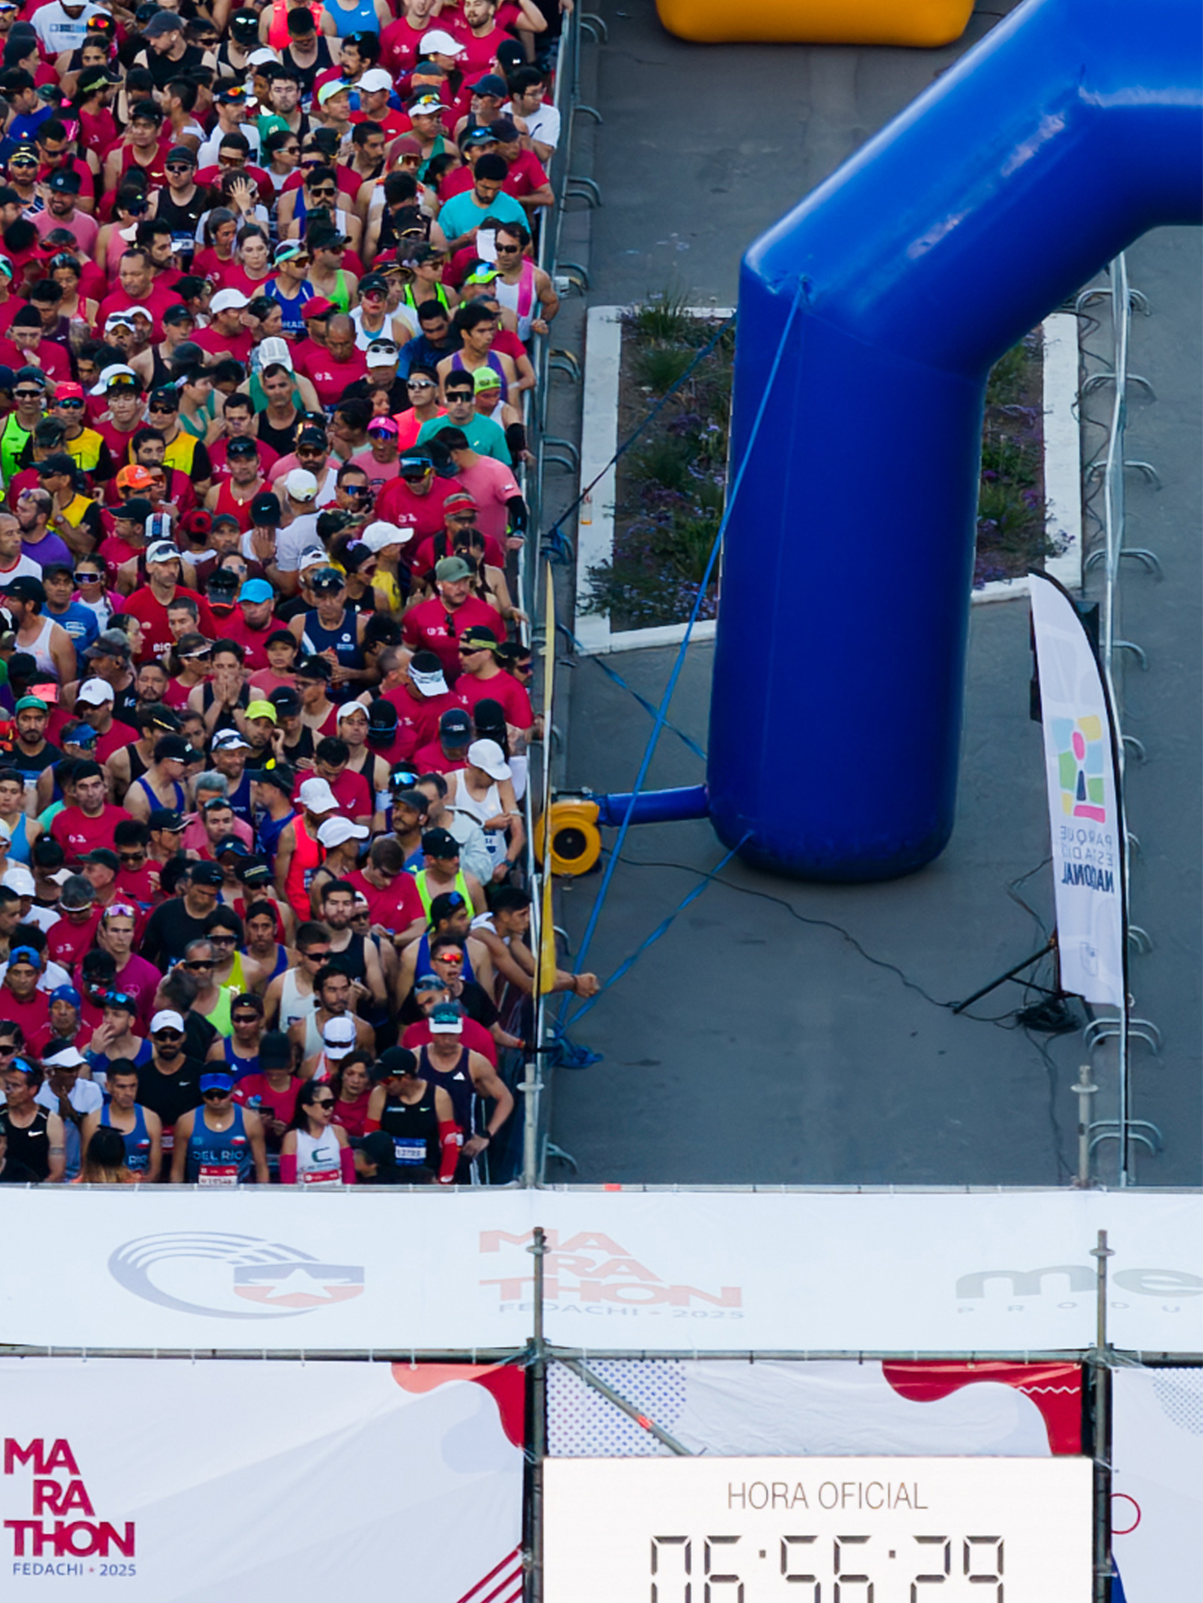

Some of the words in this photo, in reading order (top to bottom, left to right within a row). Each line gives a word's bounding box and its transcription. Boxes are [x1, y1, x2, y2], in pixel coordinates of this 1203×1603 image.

[192, 1150, 218, 1161] DEL
[479, 1228, 633, 1257] MA
[542, 1253, 665, 1282] RA
[478, 1276, 742, 1308] THON
[499, 1302, 639, 1317] FEDACHI
[671, 1309, 746, 1320] 2025
[3, 1437, 81, 1476] MA
[32, 1478, 96, 1517] RA
[727, 1482, 810, 1510] HORA
[818, 1481, 929, 1510] OFICIAL
[3, 1519, 136, 1558] THON
[12, 1562, 84, 1577] FEDACHI
[99, 1563, 137, 1577] 2025
